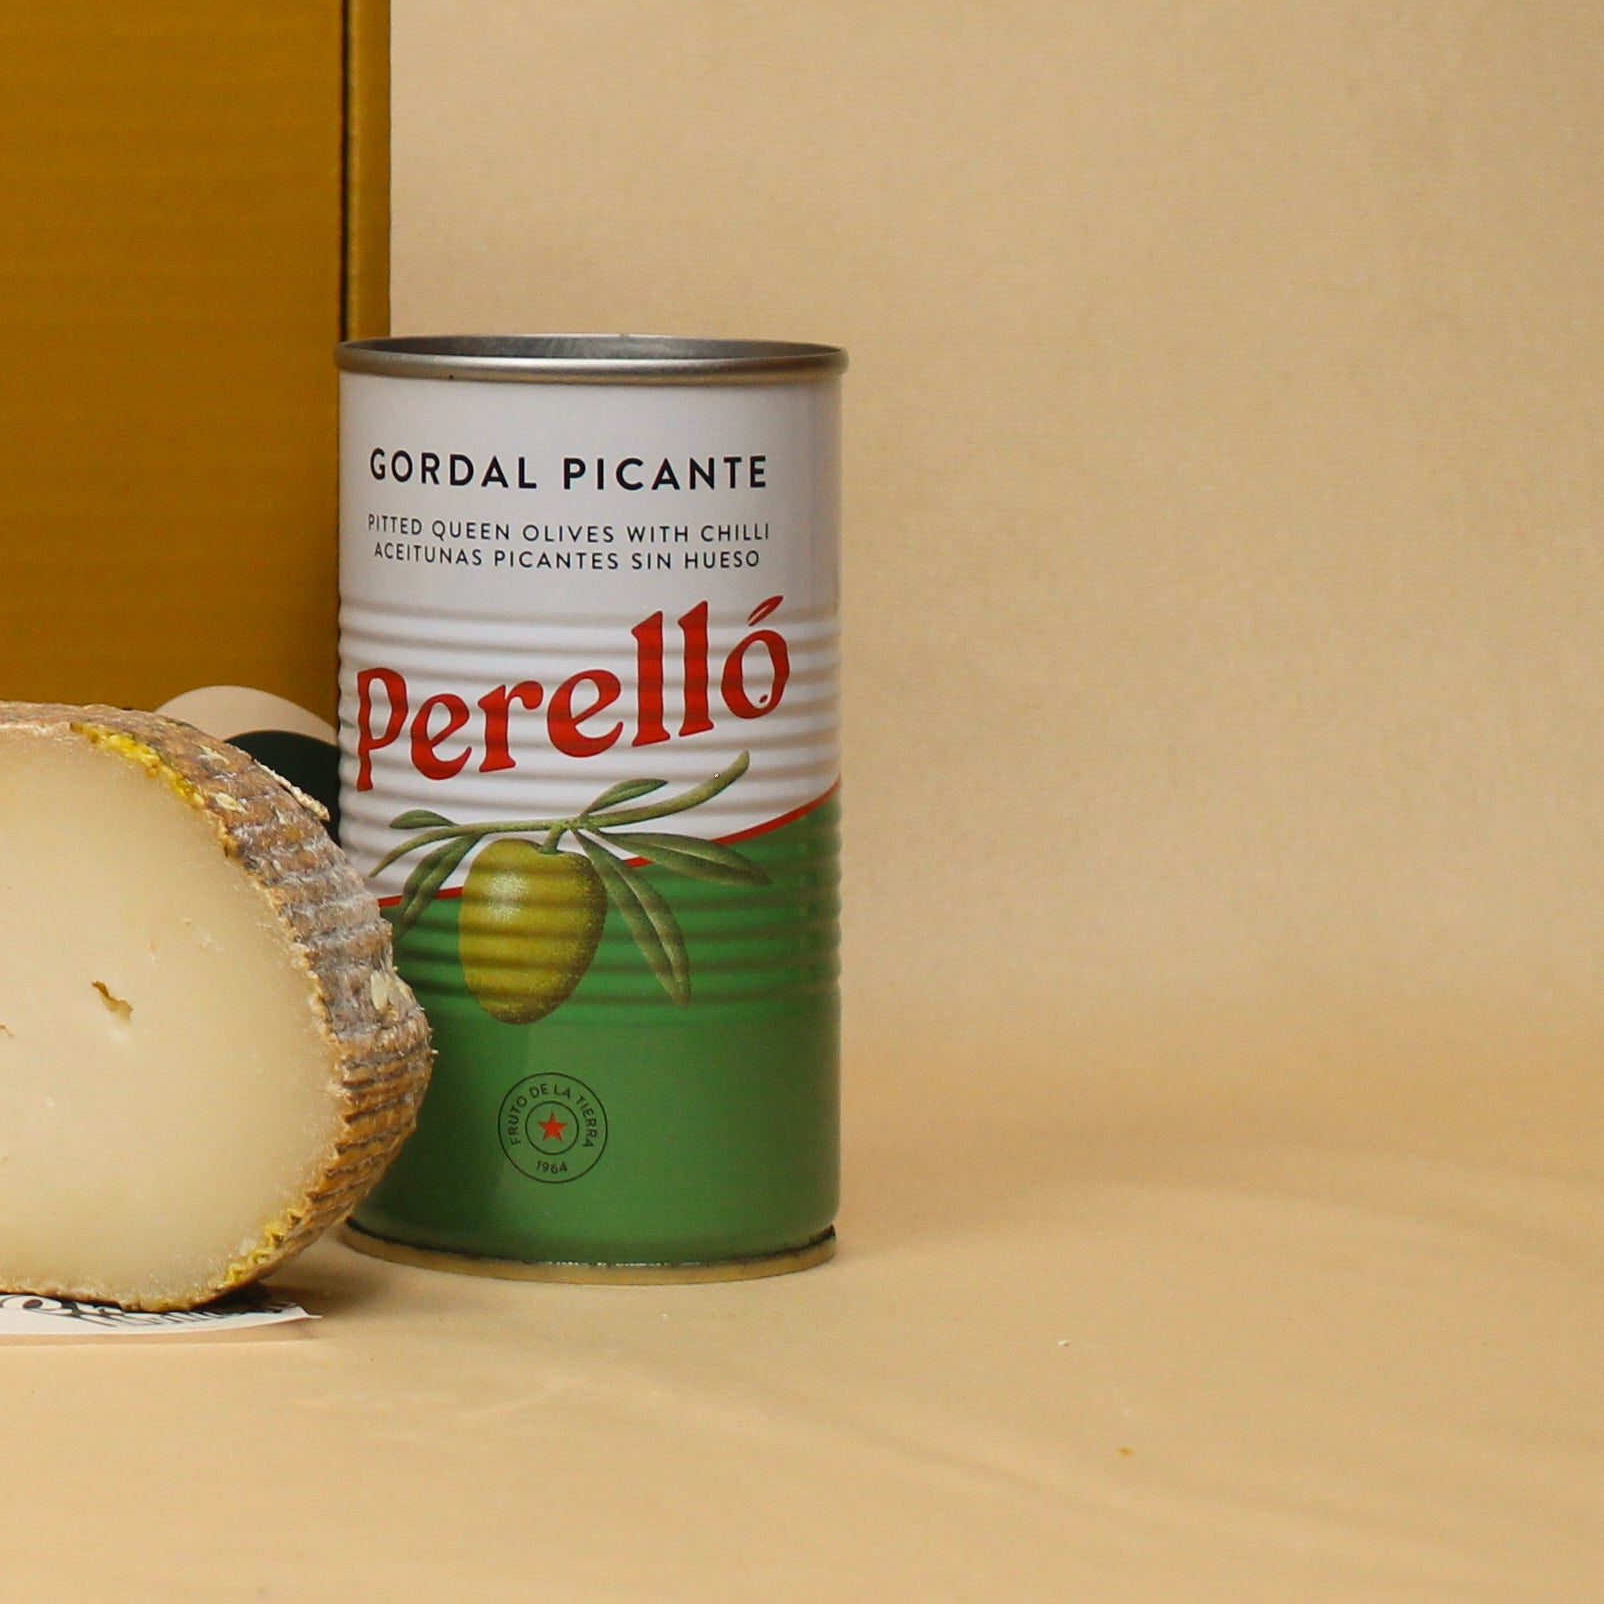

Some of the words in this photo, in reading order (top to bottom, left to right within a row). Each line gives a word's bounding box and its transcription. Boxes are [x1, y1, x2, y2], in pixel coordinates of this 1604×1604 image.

[369, 448, 537, 489] GORDAL
[563, 455, 768, 491] PICANTE
[368, 514, 422, 535] PITTED
[432, 520, 509, 541] QUEEN
[523, 525, 614, 543] OLIVES
[627, 525, 689, 543] WITH
[700, 523, 770, 542] CHILLI
[374, 542, 483, 566] ACEITUNAS
[494, 551, 619, 570] PICANTES
[631, 552, 672, 570] SIN
[684, 550, 760, 570] HUESO
[356, 595, 790, 792] Perelló
[508, 1095, 528, 1146] FRUTO
[529, 1083, 549, 1098] DE
[553, 1083, 571, 1099] LA
[575, 1094, 598, 1147] TIERRA
[536, 1160, 568, 1174] 1964
